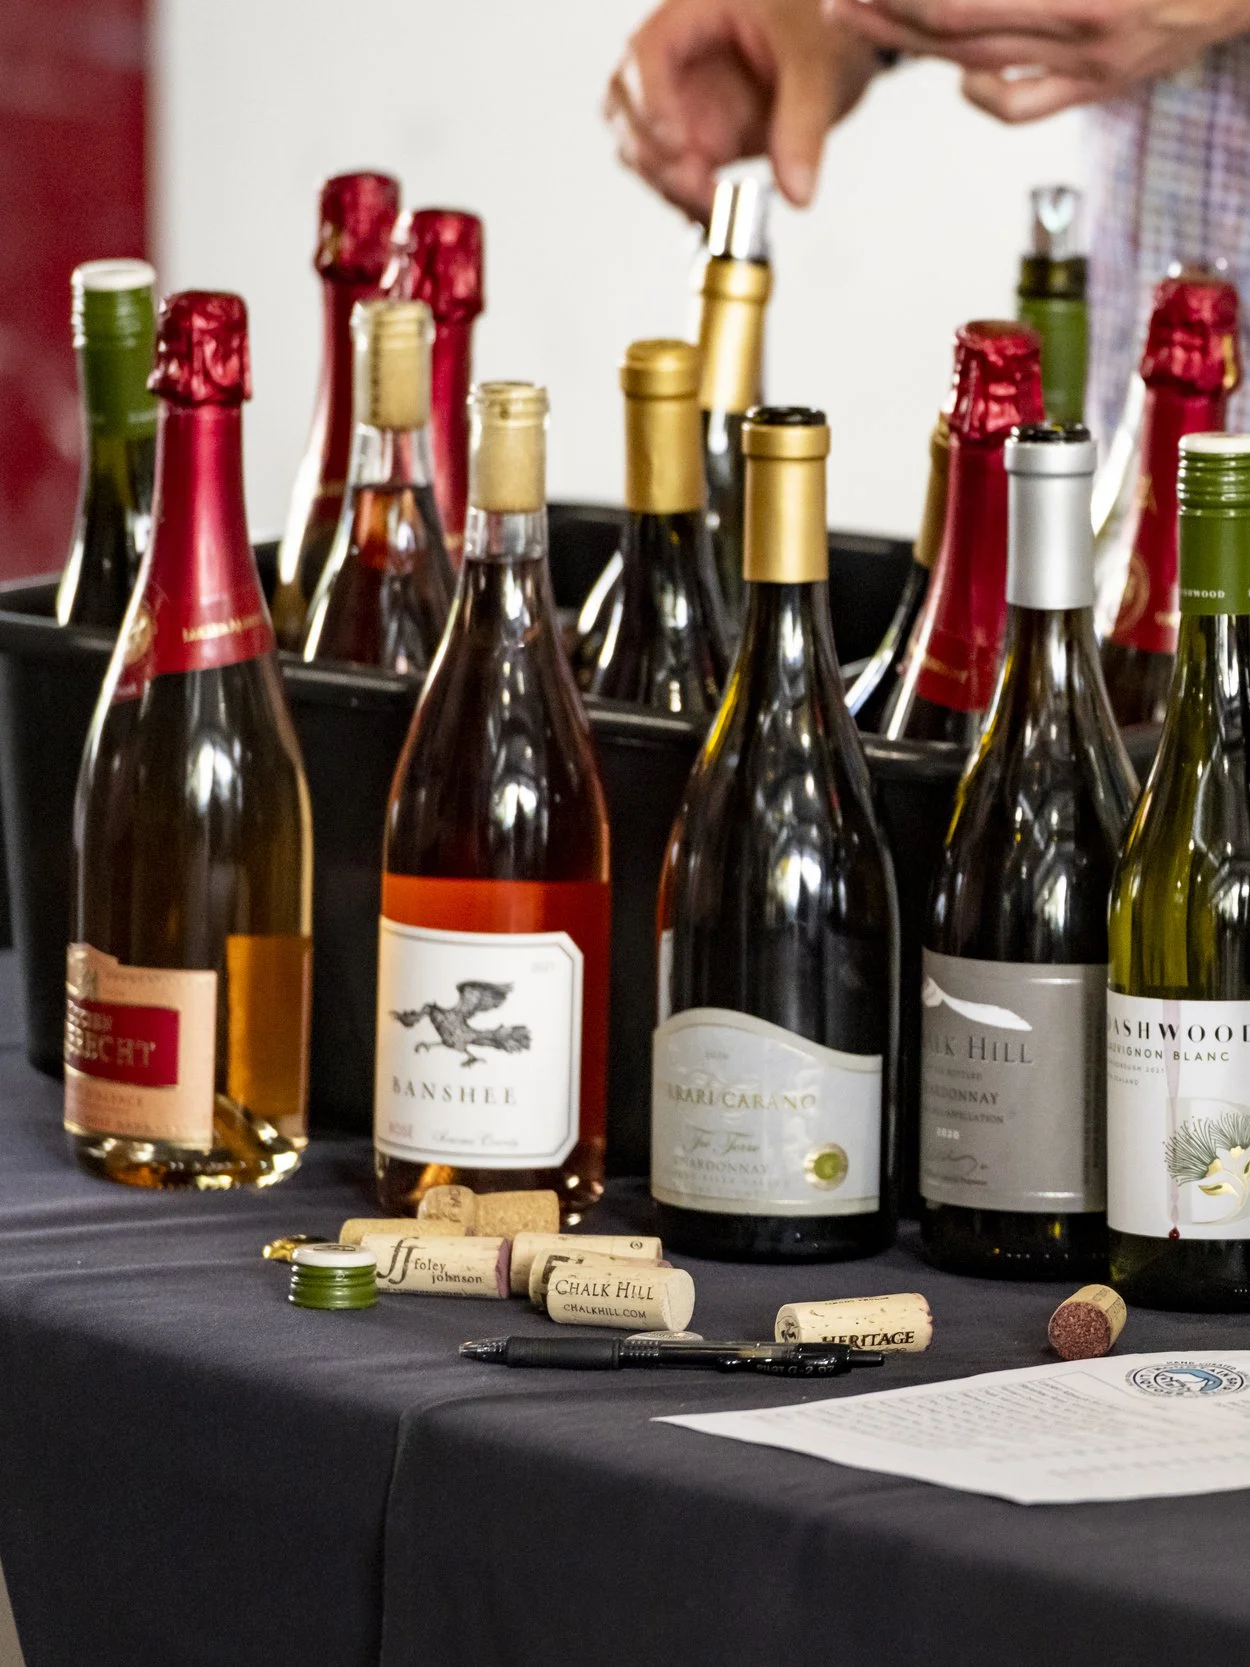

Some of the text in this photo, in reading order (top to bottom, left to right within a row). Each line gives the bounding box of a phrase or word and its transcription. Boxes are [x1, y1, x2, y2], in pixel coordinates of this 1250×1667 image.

[968, 1036, 1034, 1064] HILL
[1173, 1051, 1231, 1062] BLANC
[392, 1075, 518, 1105] BANSHEE
[721, 1089, 817, 1112] CARANO
[414, 1258, 447, 1274] foley
[432, 1271, 483, 1284] johnson
[555, 1279, 655, 1300] CHALK HILL
[563, 1303, 648, 1319] CHALKHILL.COM
[821, 1330, 916, 1350] HERITAGE
